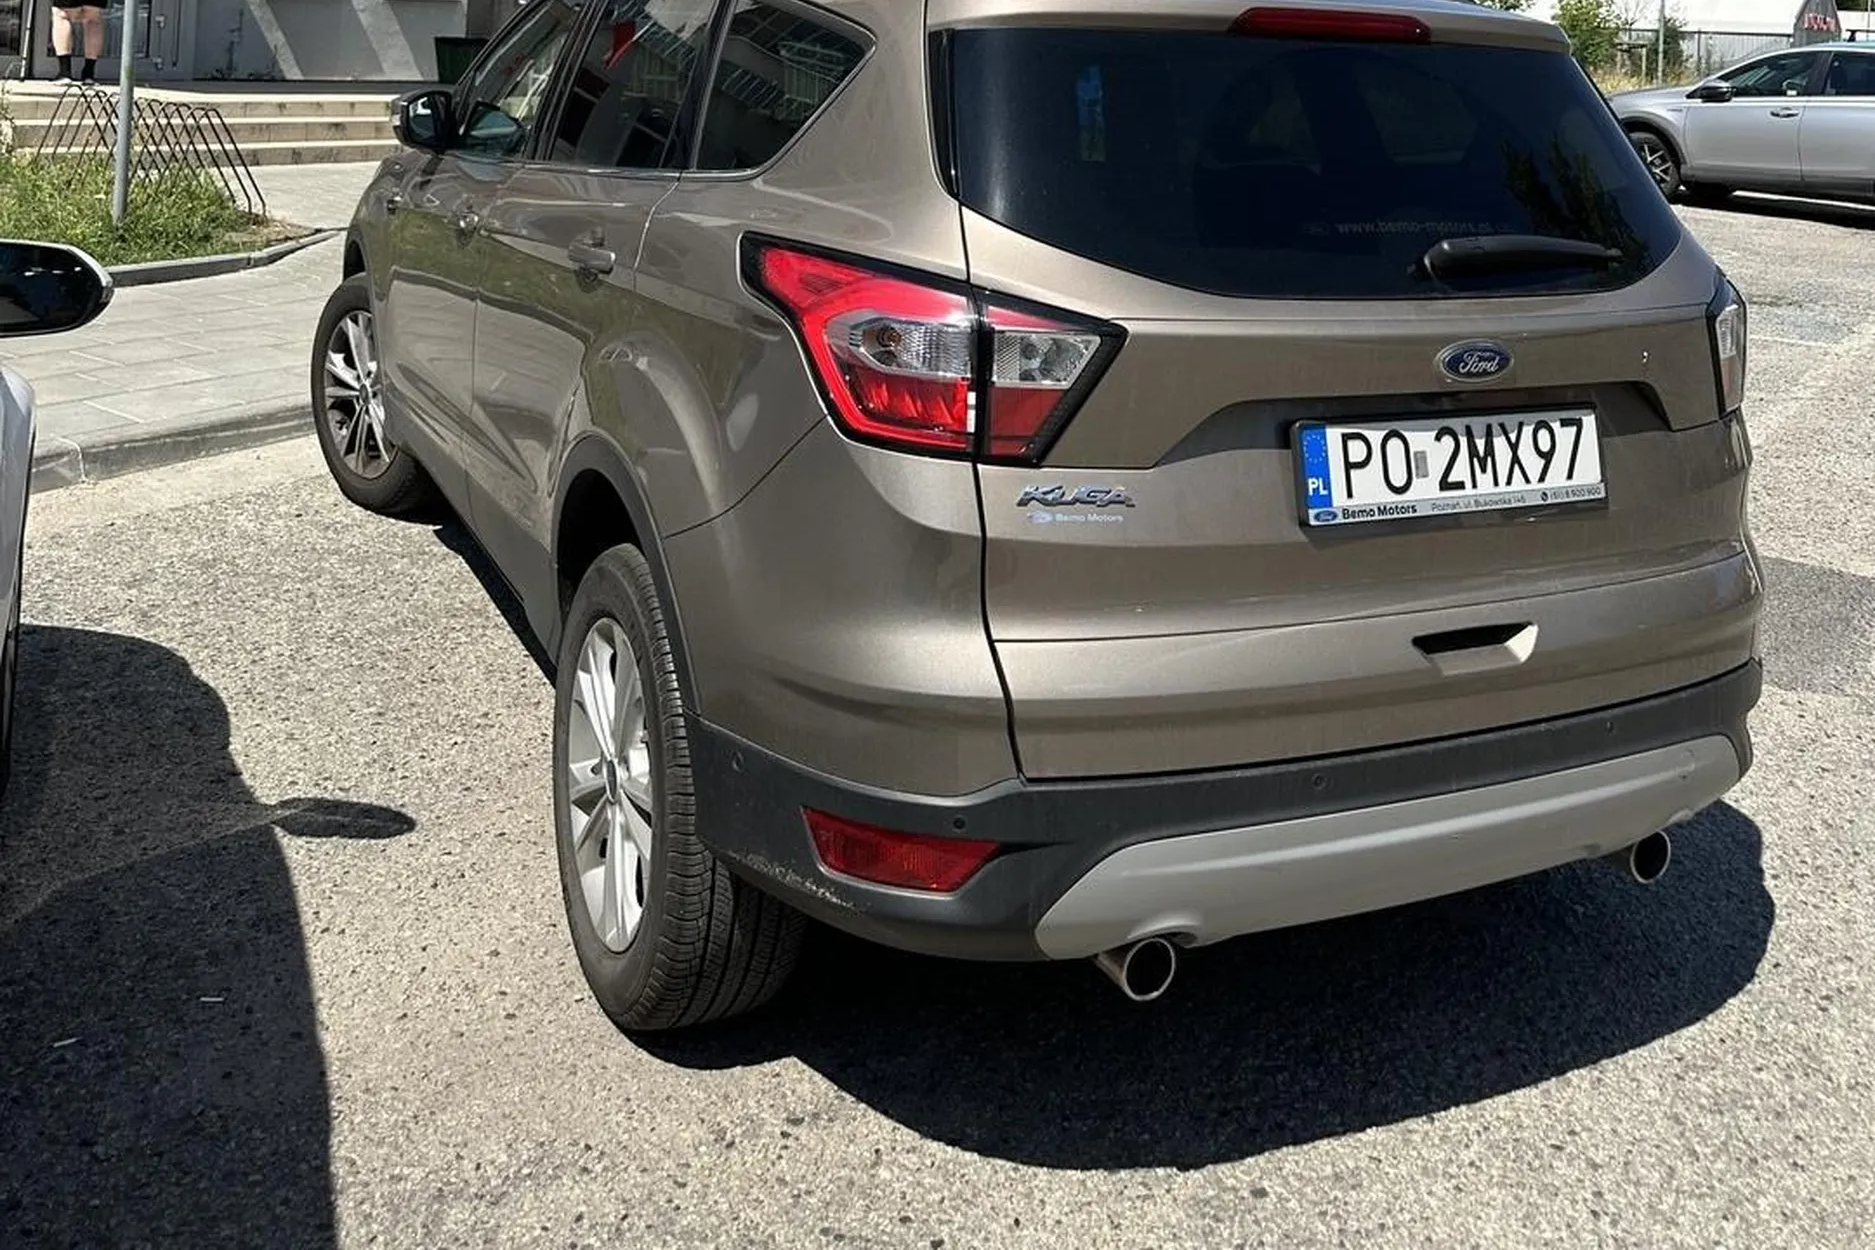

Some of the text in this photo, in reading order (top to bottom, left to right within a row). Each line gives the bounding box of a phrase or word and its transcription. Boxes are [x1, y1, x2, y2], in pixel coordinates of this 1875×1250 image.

[1458, 350, 1500, 374] Ford
[1339, 417, 1584, 499] PO 2MX97
[1016, 485, 1135, 507] KUGA
[1307, 478, 1329, 497] PL
[1055, 513, 1124, 523] Bemo Motors
[1341, 508, 1376, 520] Bemo
[1377, 504, 1418, 517] Motors
